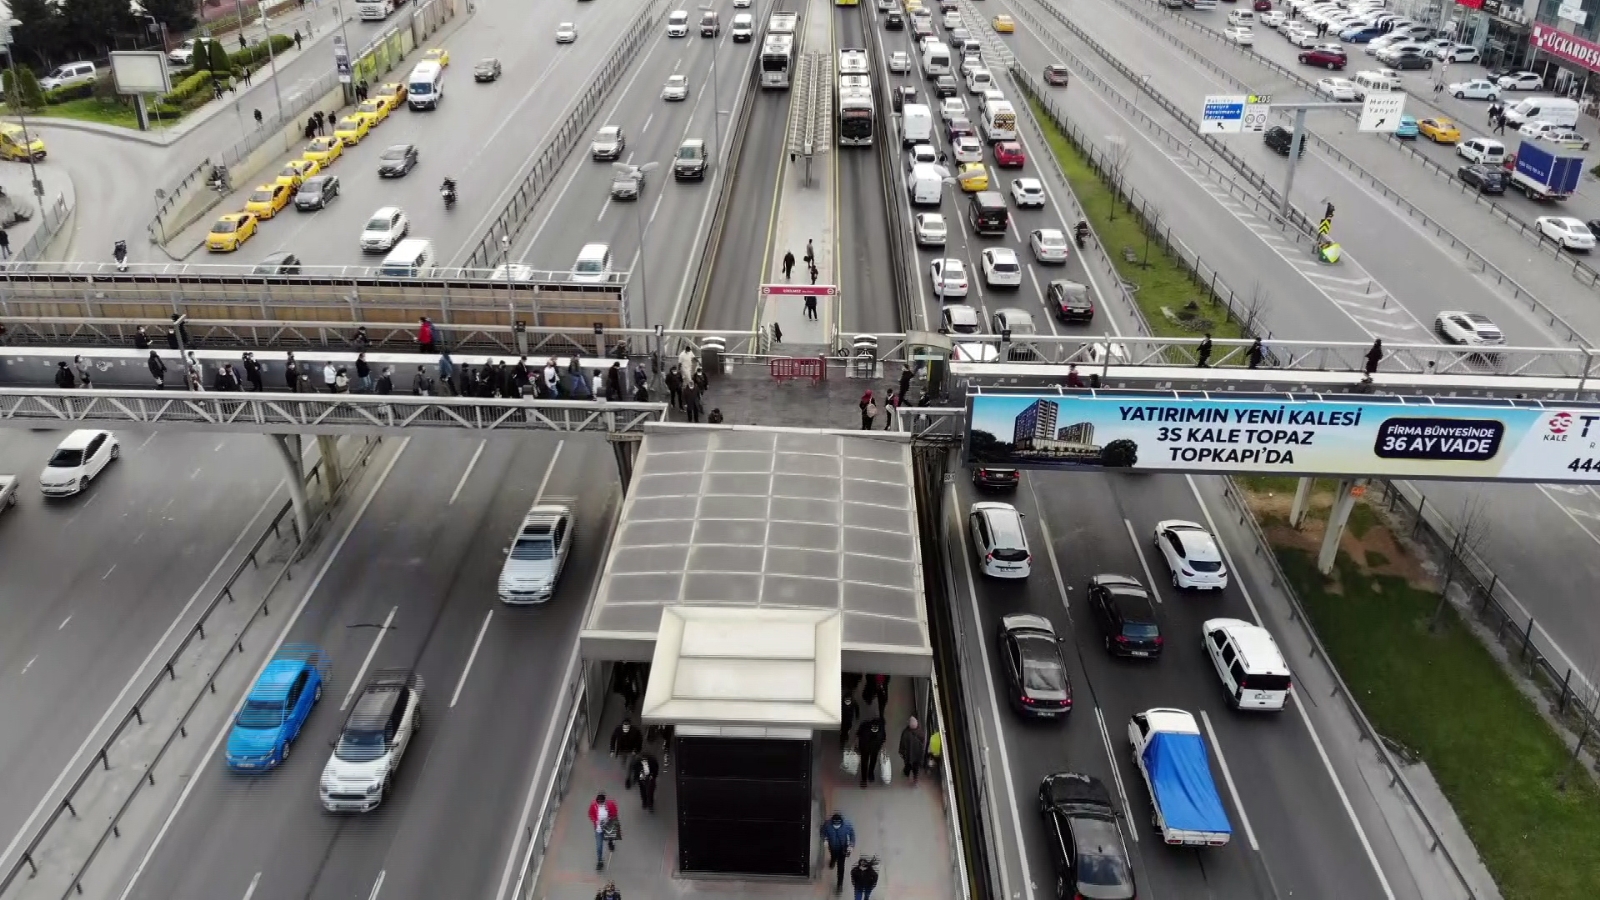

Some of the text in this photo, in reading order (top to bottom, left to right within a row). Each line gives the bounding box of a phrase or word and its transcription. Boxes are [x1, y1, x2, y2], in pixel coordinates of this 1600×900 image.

[1119, 405, 1363, 426] YATIRIMIN YENİ KALESİ
[1156, 427, 1315, 445] 3S KALE TOPAZ
[1387, 425, 1495, 438] FİRMA BÜNYESİNDE
[1543, 434, 1568, 442] KALE
[1383, 436, 1493, 453] 36 AY VADE
[1169, 447, 1295, 464] TOPKAPI'DA
